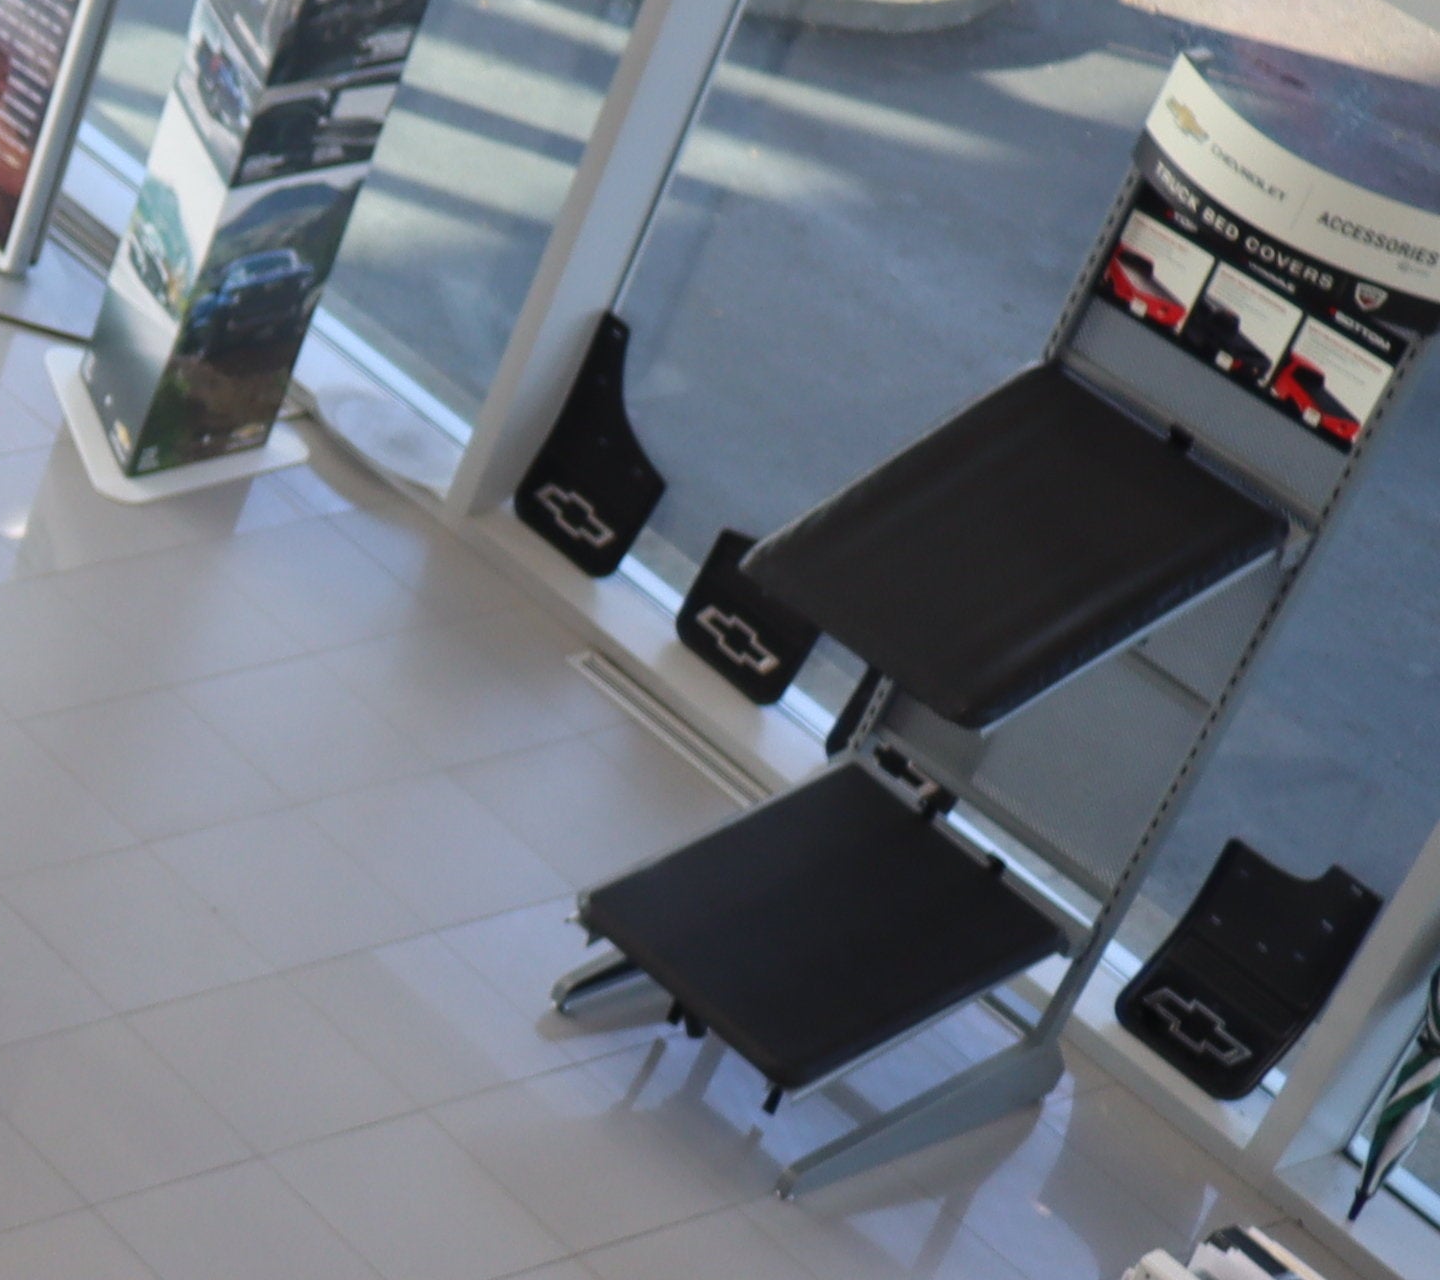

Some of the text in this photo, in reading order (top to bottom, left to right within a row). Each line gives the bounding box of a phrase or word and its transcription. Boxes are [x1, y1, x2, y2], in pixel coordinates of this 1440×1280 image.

[1211, 143, 1287, 202] CHEVROLET
[1155, 159, 1200, 214] TRUCK
[1202, 206, 1240, 242] BED
[1244, 235, 1334, 292] COVERS
[1317, 211, 1440, 266] ACCESSORIES
